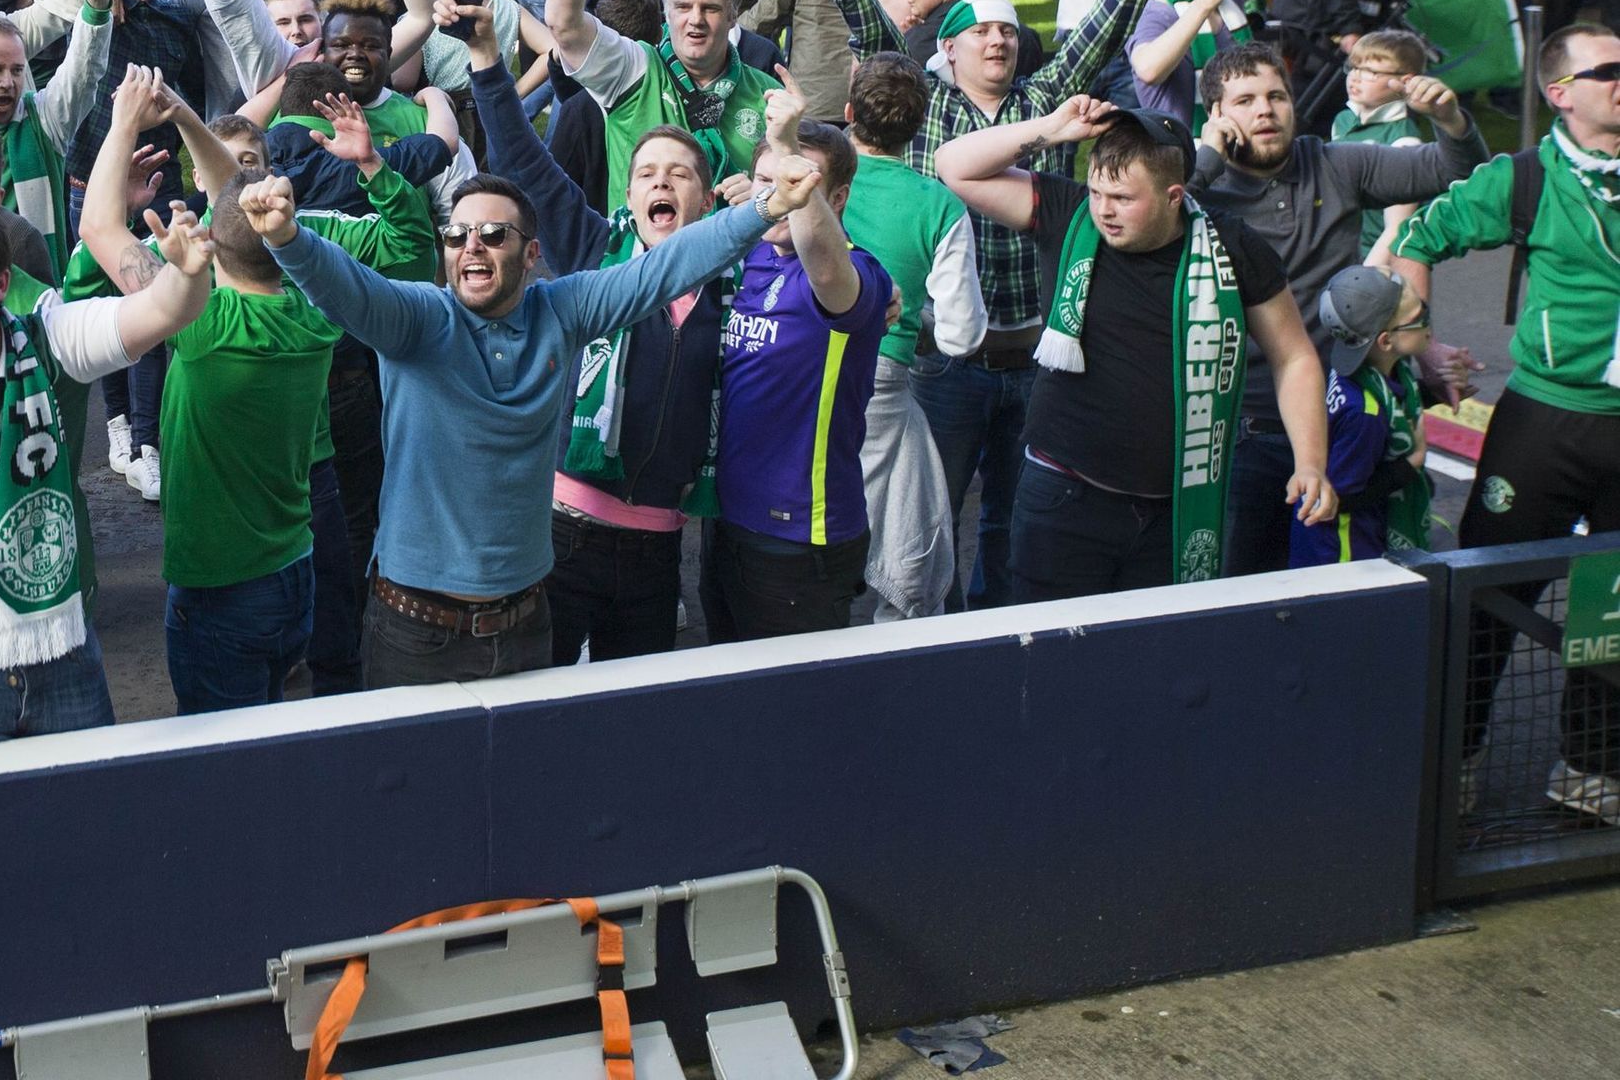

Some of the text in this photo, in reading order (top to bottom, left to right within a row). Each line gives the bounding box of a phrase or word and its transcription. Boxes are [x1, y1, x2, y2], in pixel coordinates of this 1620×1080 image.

[1061, 285, 1073, 299] 18
[1219, 318, 1242, 394] CUP
[1566, 634, 1620, 664] EME
